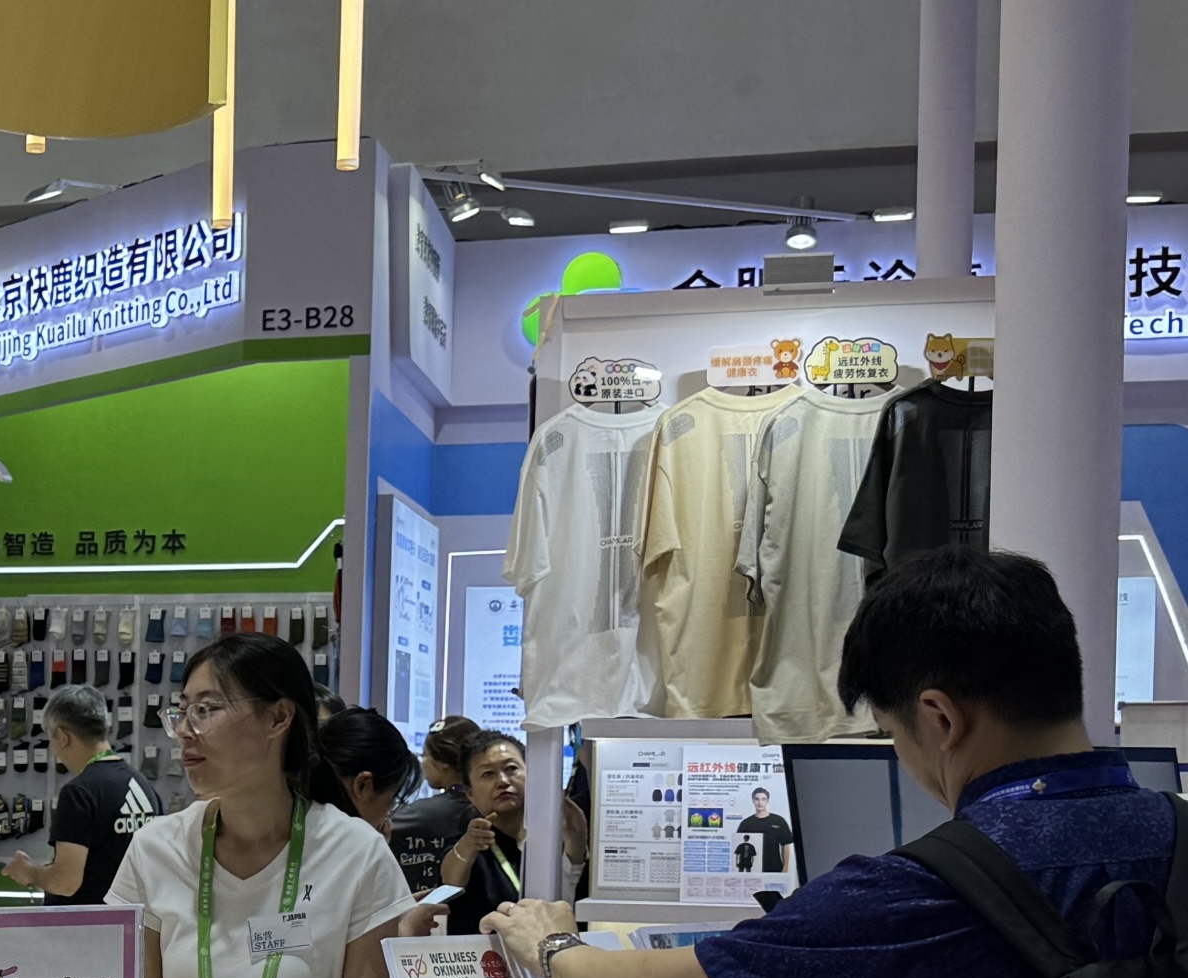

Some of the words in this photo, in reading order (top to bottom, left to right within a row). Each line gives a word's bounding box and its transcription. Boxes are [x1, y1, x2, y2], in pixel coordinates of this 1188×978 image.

[1128, 246, 1183, 298] 技
[35, 316, 87, 347] Kuailu
[91, 295, 162, 336] Knitting
[165, 274, 233, 313] Co.,Ltd
[261, 304, 355, 332] E3-B28
[1124, 312, 1184, 335] ech
[710, 356, 773, 368] 缓解肩颈疼痛
[837, 356, 882, 367] 远红外线
[726, 367, 758, 378] 健康衣
[833, 368, 889, 379] 疲劳恢复衣
[600, 387, 645, 399] 原装进口
[75, 528, 187, 556] 品质为本
[687, 762, 785, 773] 远红外线健康T恤
[113, 812, 154, 834] adid
[254, 938, 286, 950] STAFF
[428, 951, 478, 964] WELLNESS
[433, 964, 478, 977] OKINAWA
